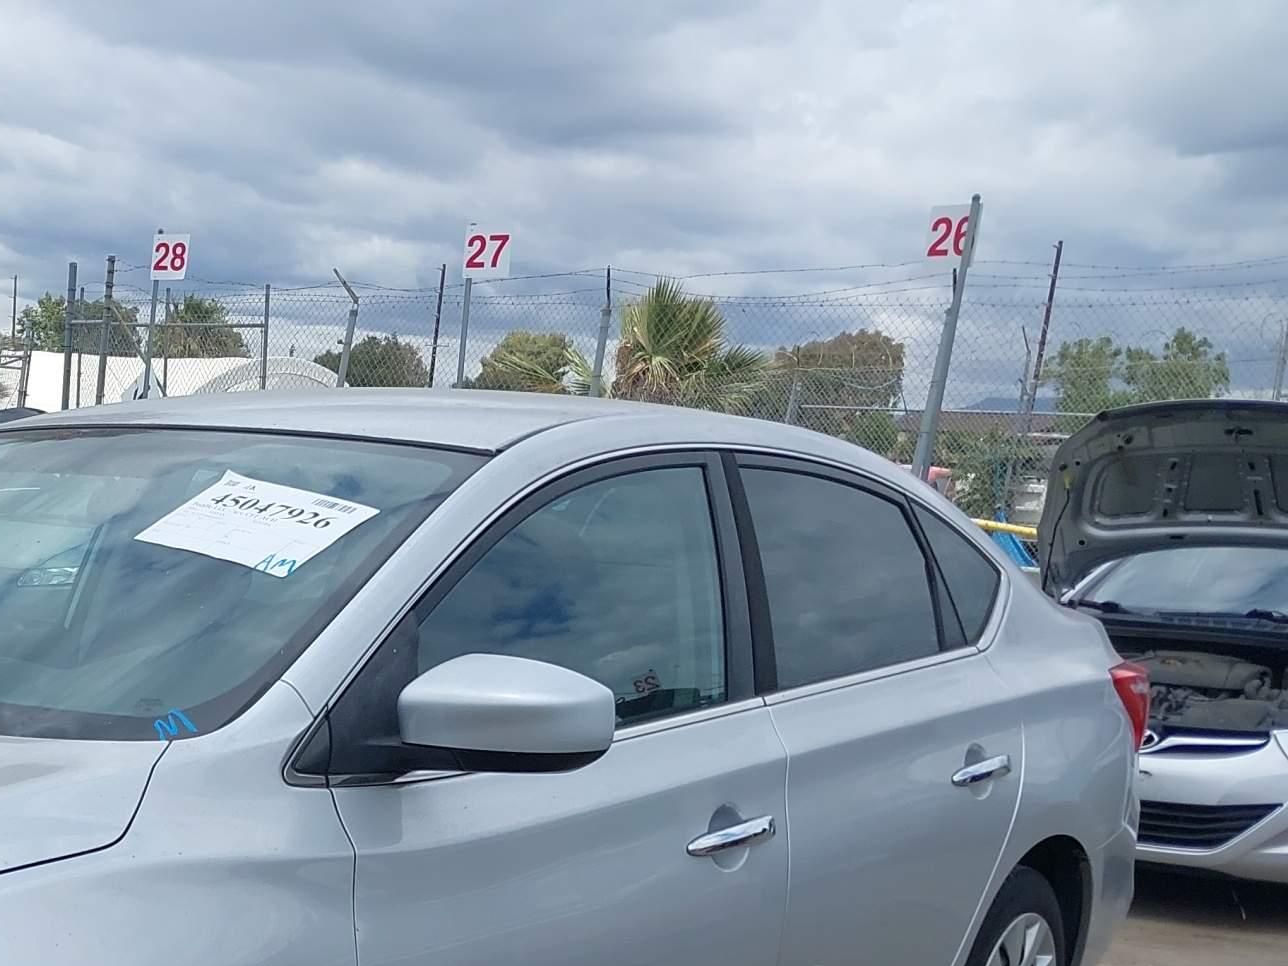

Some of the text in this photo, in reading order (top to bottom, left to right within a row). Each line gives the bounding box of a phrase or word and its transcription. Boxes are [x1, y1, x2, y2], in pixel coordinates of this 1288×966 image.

[465, 234, 510, 268] 27
[926, 215, 969, 257] 26
[153, 242, 187, 272] 28
[210, 493, 338, 529] 45047926
